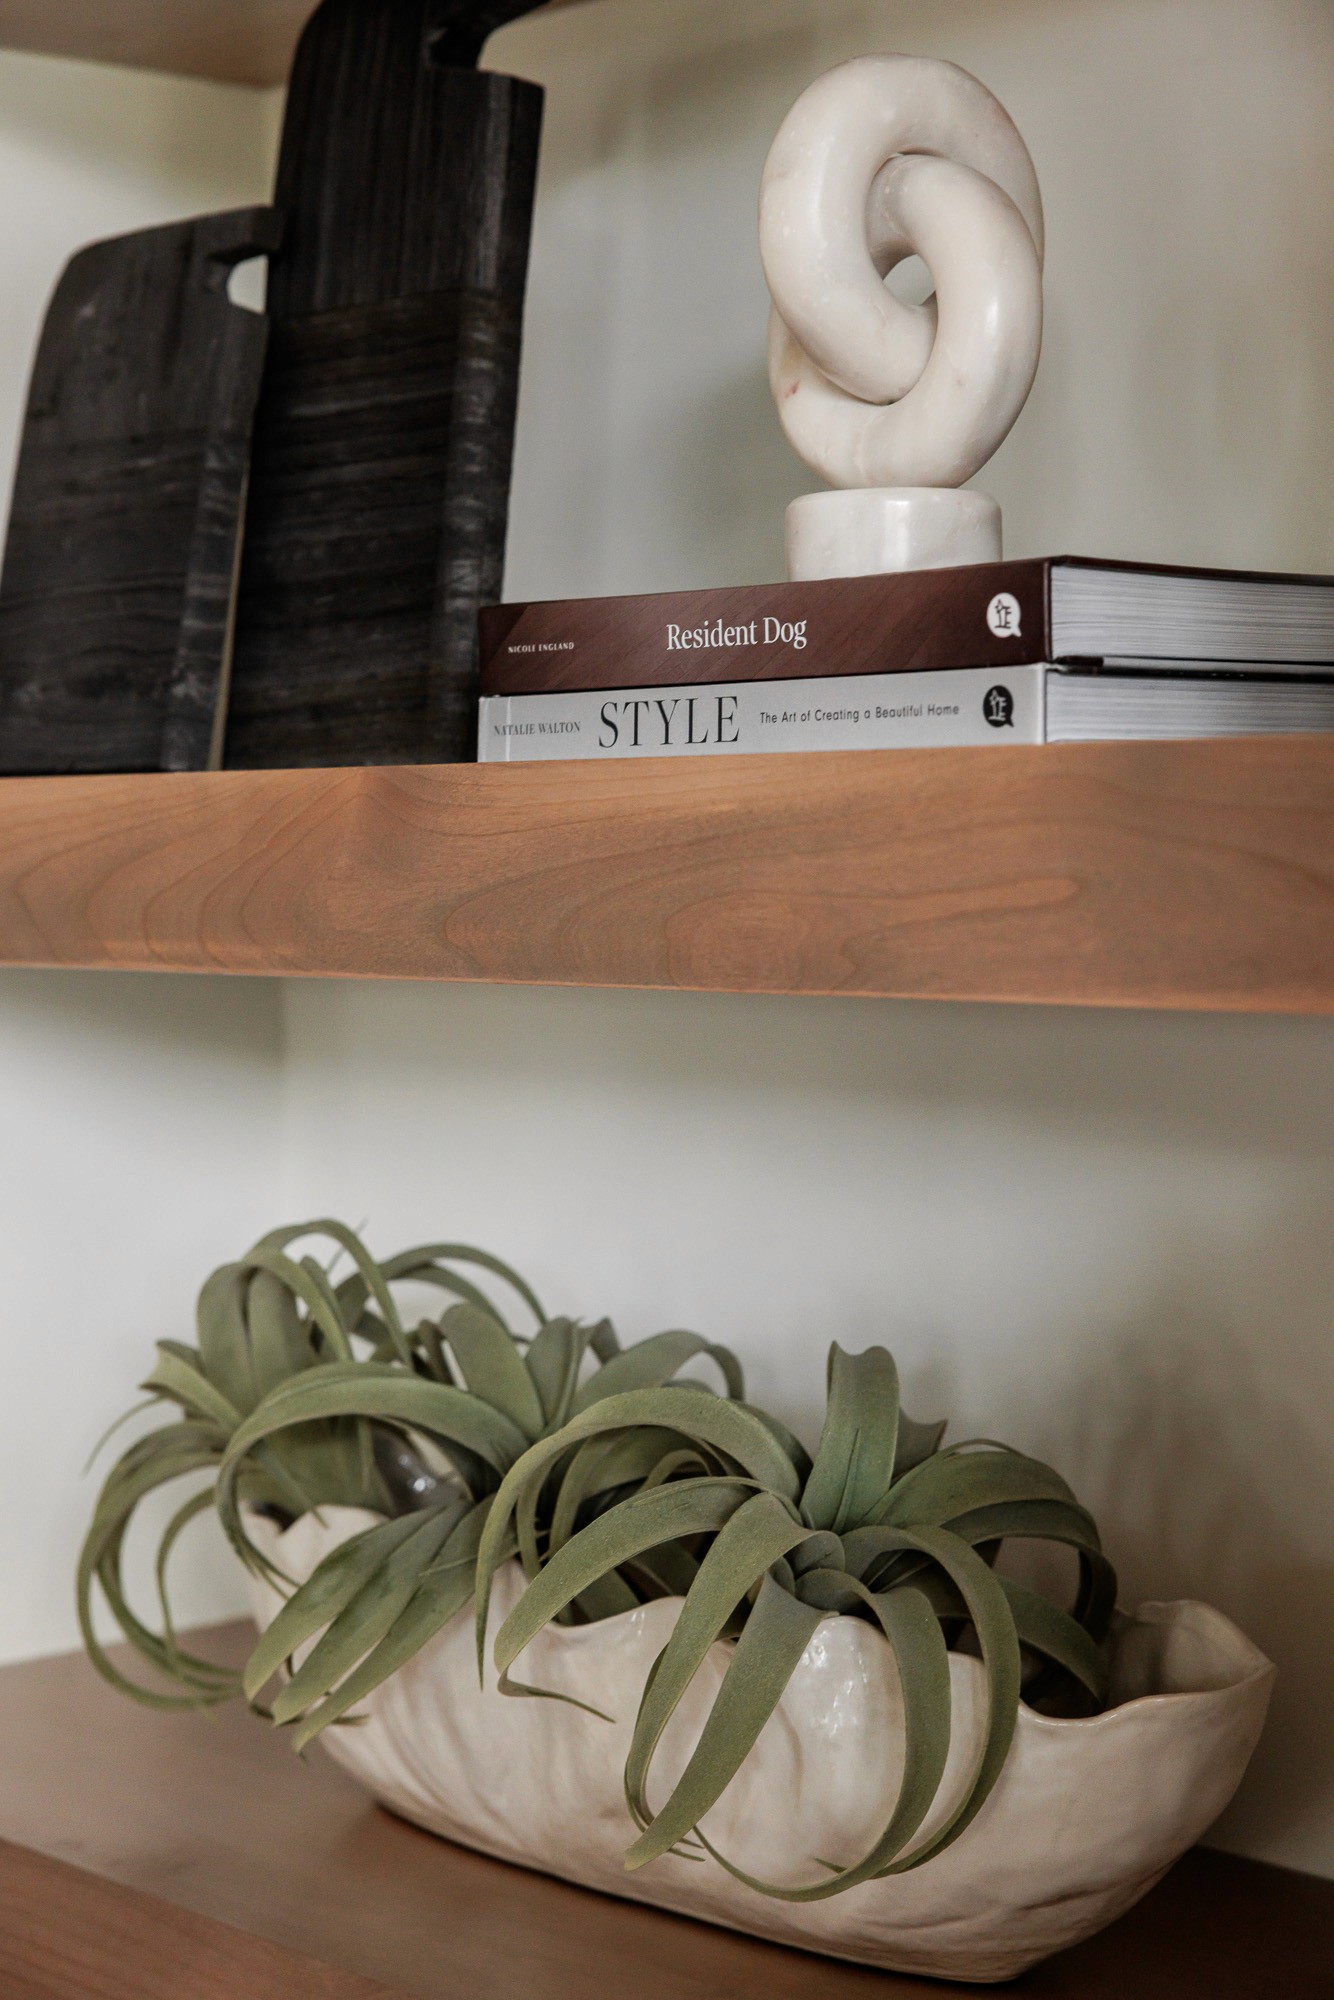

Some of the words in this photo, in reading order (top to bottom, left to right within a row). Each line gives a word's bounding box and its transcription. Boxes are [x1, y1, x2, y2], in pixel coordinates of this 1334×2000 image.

[666, 617, 757, 651] Resident
[763, 616, 807, 650] Dog
[508, 645, 536, 654] NICOLE
[538, 642, 574, 652] ENGLAND
[599, 696, 740, 748] STYLE
[760, 712, 777, 724] The
[782, 711, 797, 723] Art
[800, 710, 811, 722] of
[814, 708, 859, 723] Creating
[864, 710, 871, 720] a
[875, 704, 922, 719] Beautiful
[927, 704, 960, 716] Home
[494, 724, 535, 736] NATALIE
[538, 721, 581, 734] WALTON
